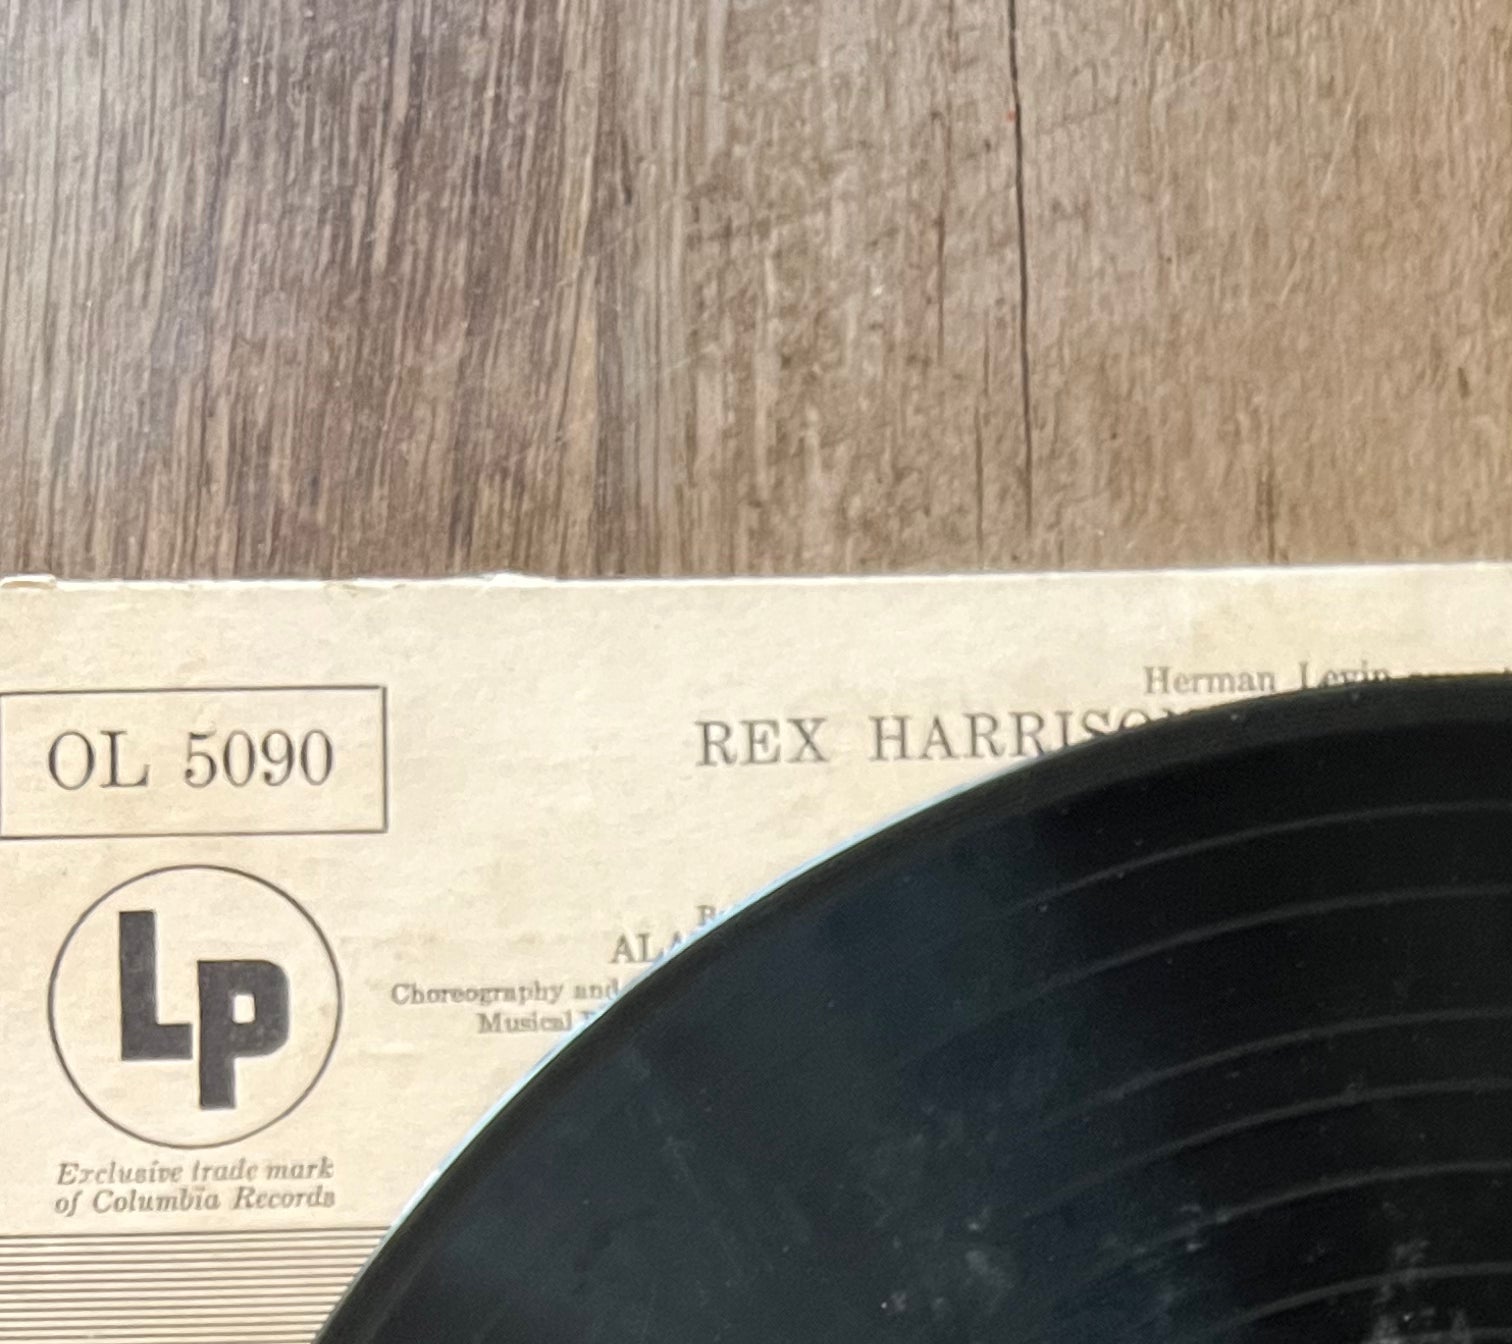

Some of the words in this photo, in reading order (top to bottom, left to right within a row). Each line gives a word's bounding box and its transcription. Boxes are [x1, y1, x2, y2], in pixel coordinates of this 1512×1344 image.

[1143, 664, 1275, 694] Herman
[694, 717, 829, 767] REX
[47, 730, 149, 791] OL
[184, 729, 334, 788] 5090
[390, 980, 564, 1006] Choreography
[476, 1008, 573, 1034] Musical
[56, 1159, 184, 1186] Exclusive
[191, 1157, 259, 1182] trade
[265, 1155, 334, 1180] mark
[54, 1189, 84, 1218] of
[91, 1187, 221, 1214] Columbia
[232, 1184, 335, 1210] Records
